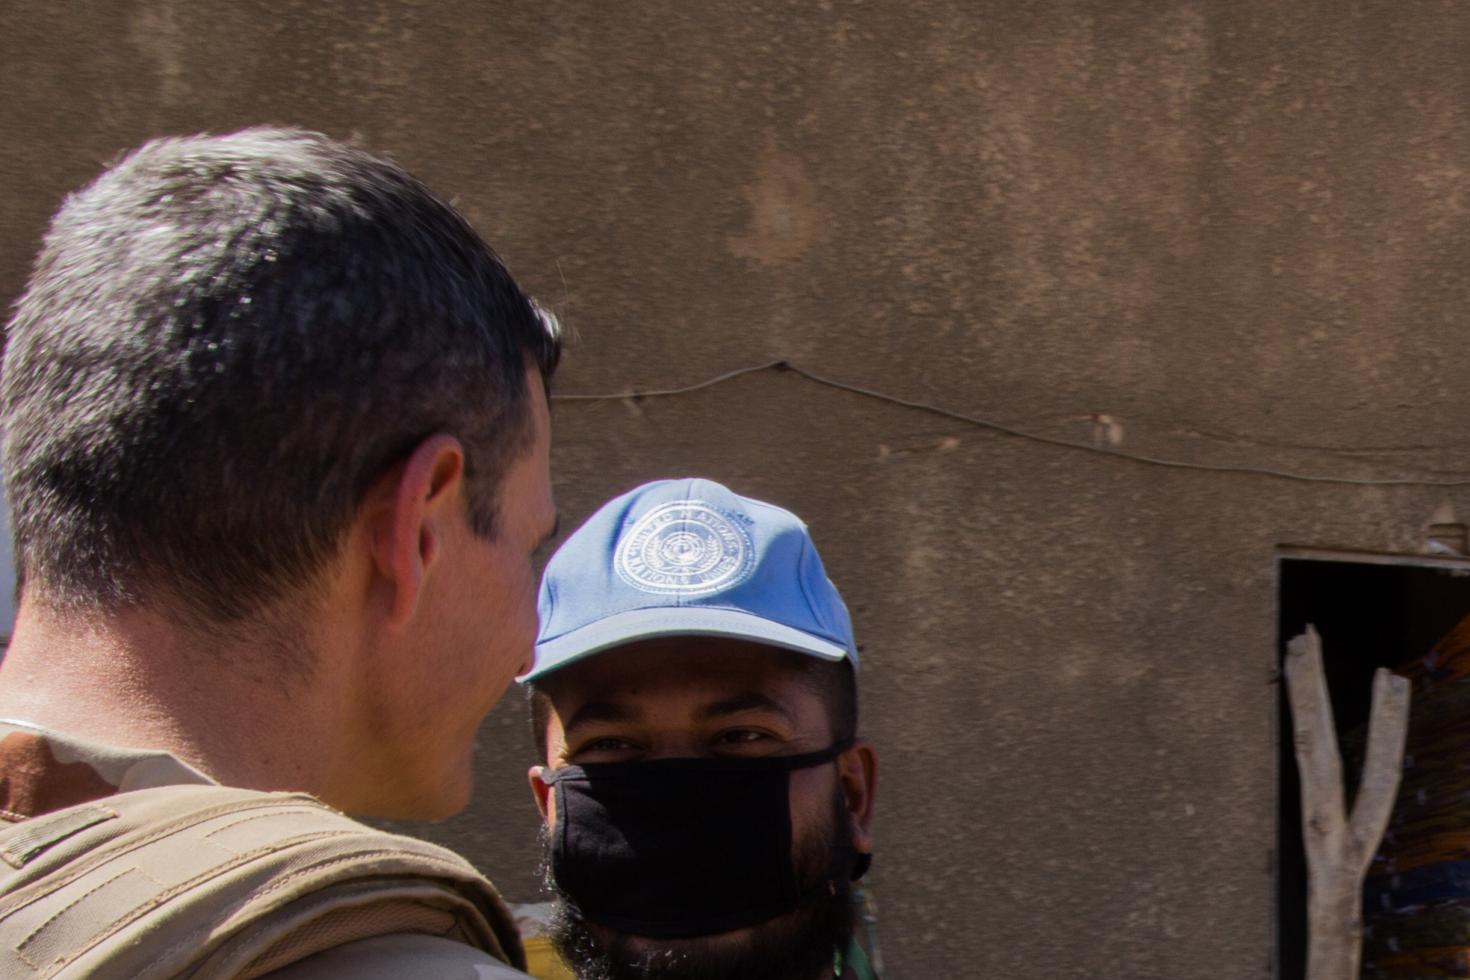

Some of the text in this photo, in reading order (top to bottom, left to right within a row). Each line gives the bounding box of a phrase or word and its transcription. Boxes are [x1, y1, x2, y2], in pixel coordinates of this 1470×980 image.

[631, 510, 738, 551] UNITED NATIONS
[630, 557, 689, 584] NATIONS
